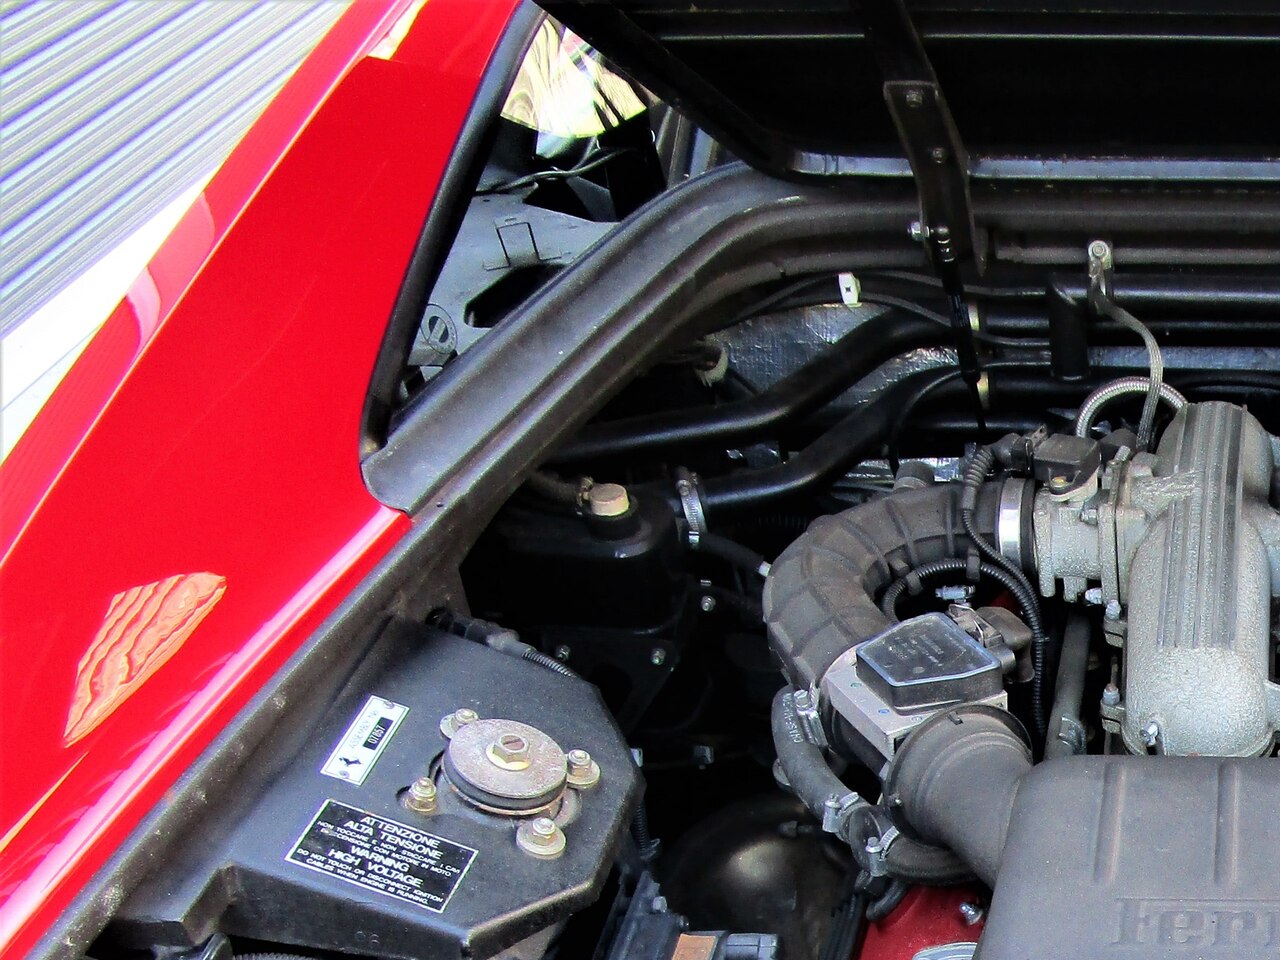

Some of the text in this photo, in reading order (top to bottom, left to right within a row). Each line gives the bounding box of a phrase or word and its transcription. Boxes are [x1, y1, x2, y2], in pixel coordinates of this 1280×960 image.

[316, 820, 334, 830] NON
[335, 827, 369, 842] TOCCARE
[379, 842, 397, 852] NON
[400, 849, 437, 866] STACCARE
[444, 865, 461, 874] CAVI
[343, 820, 443, 860] ALTA TENSIONE
[360, 815, 441, 849] ATTENZIONE
[305, 858, 335, 872] CABLES
[335, 868, 358, 880] WHEN
[359, 877, 386, 890] ENGINE
[327, 848, 423, 888] HIGH VOLTAGE
[348, 845, 411, 873] WARNING
[372, 846, 390, 856] CON
[390, 852, 420, 867] MOTORE
[296, 848, 443, 903] DO NOT TOUCH OR DISCONNECT IGNITION
